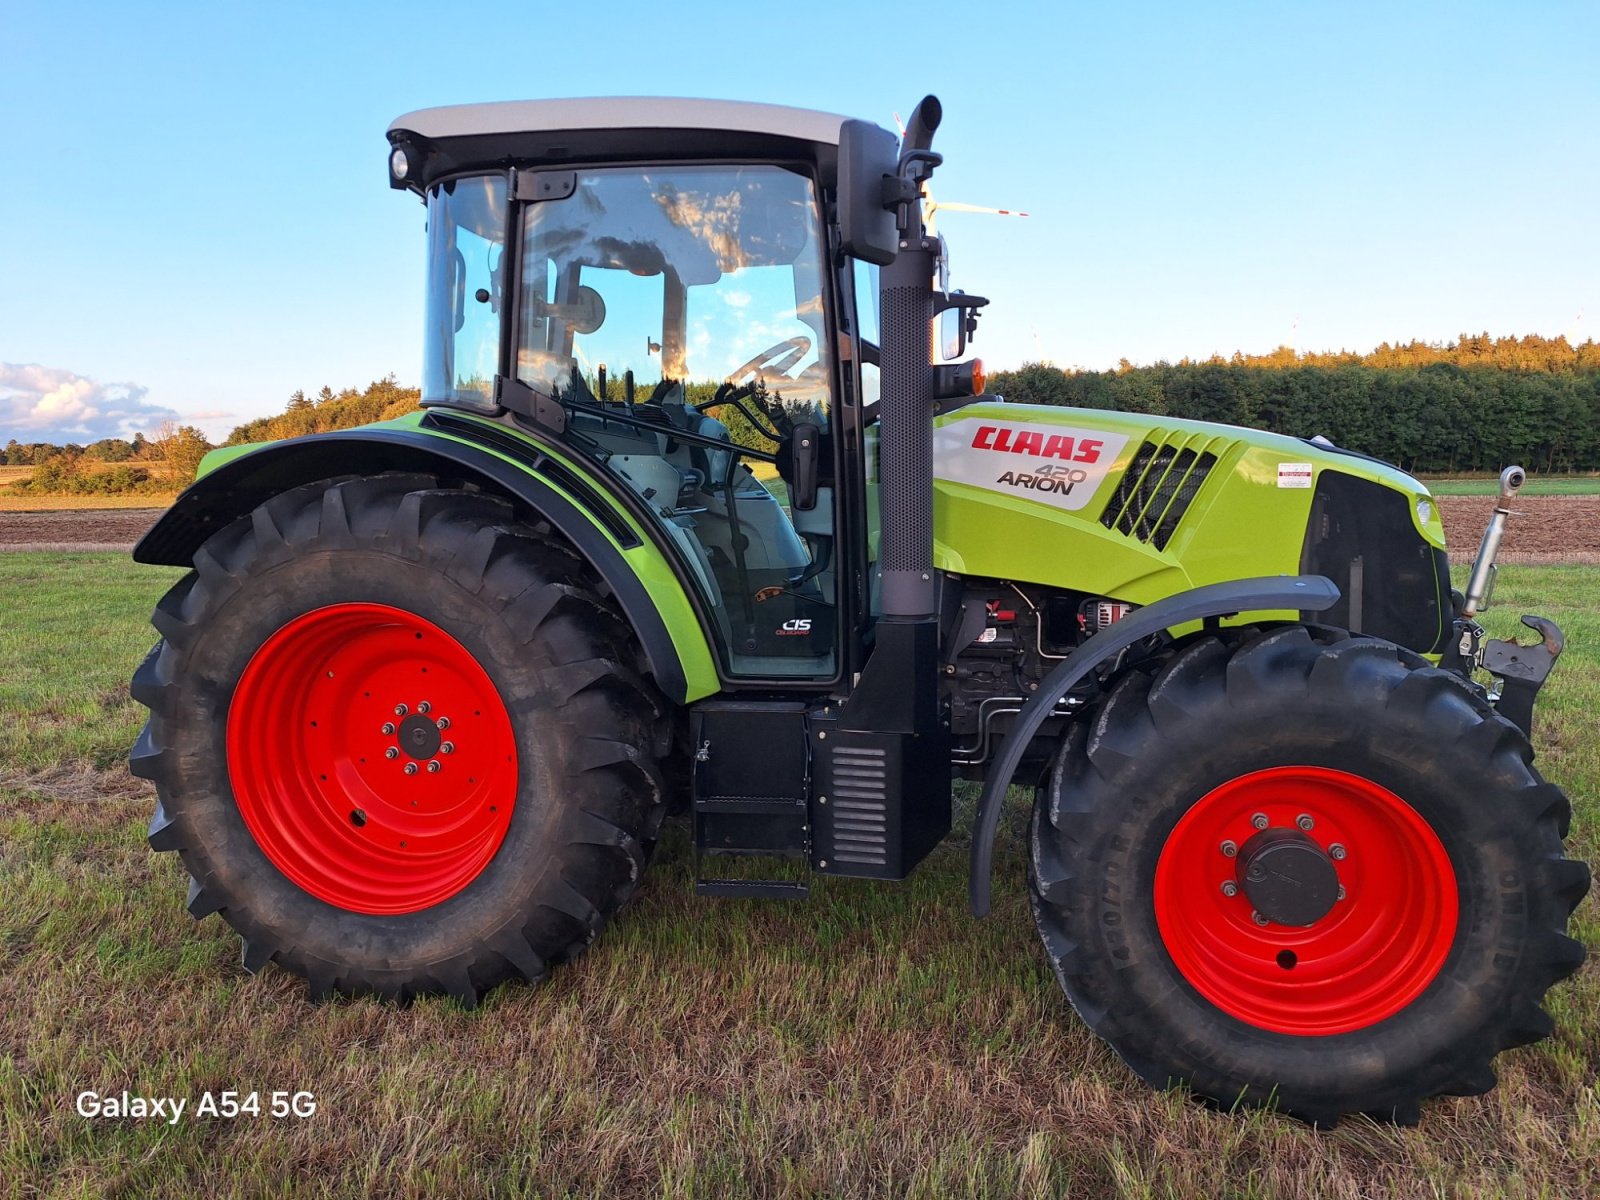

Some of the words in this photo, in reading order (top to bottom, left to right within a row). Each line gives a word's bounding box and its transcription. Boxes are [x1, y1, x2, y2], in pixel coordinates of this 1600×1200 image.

[971, 426, 1104, 464] CLAAS
[996, 471, 1075, 496] ARION
[1034, 464, 1088, 484] 420
[782, 619, 812, 630] CIS
